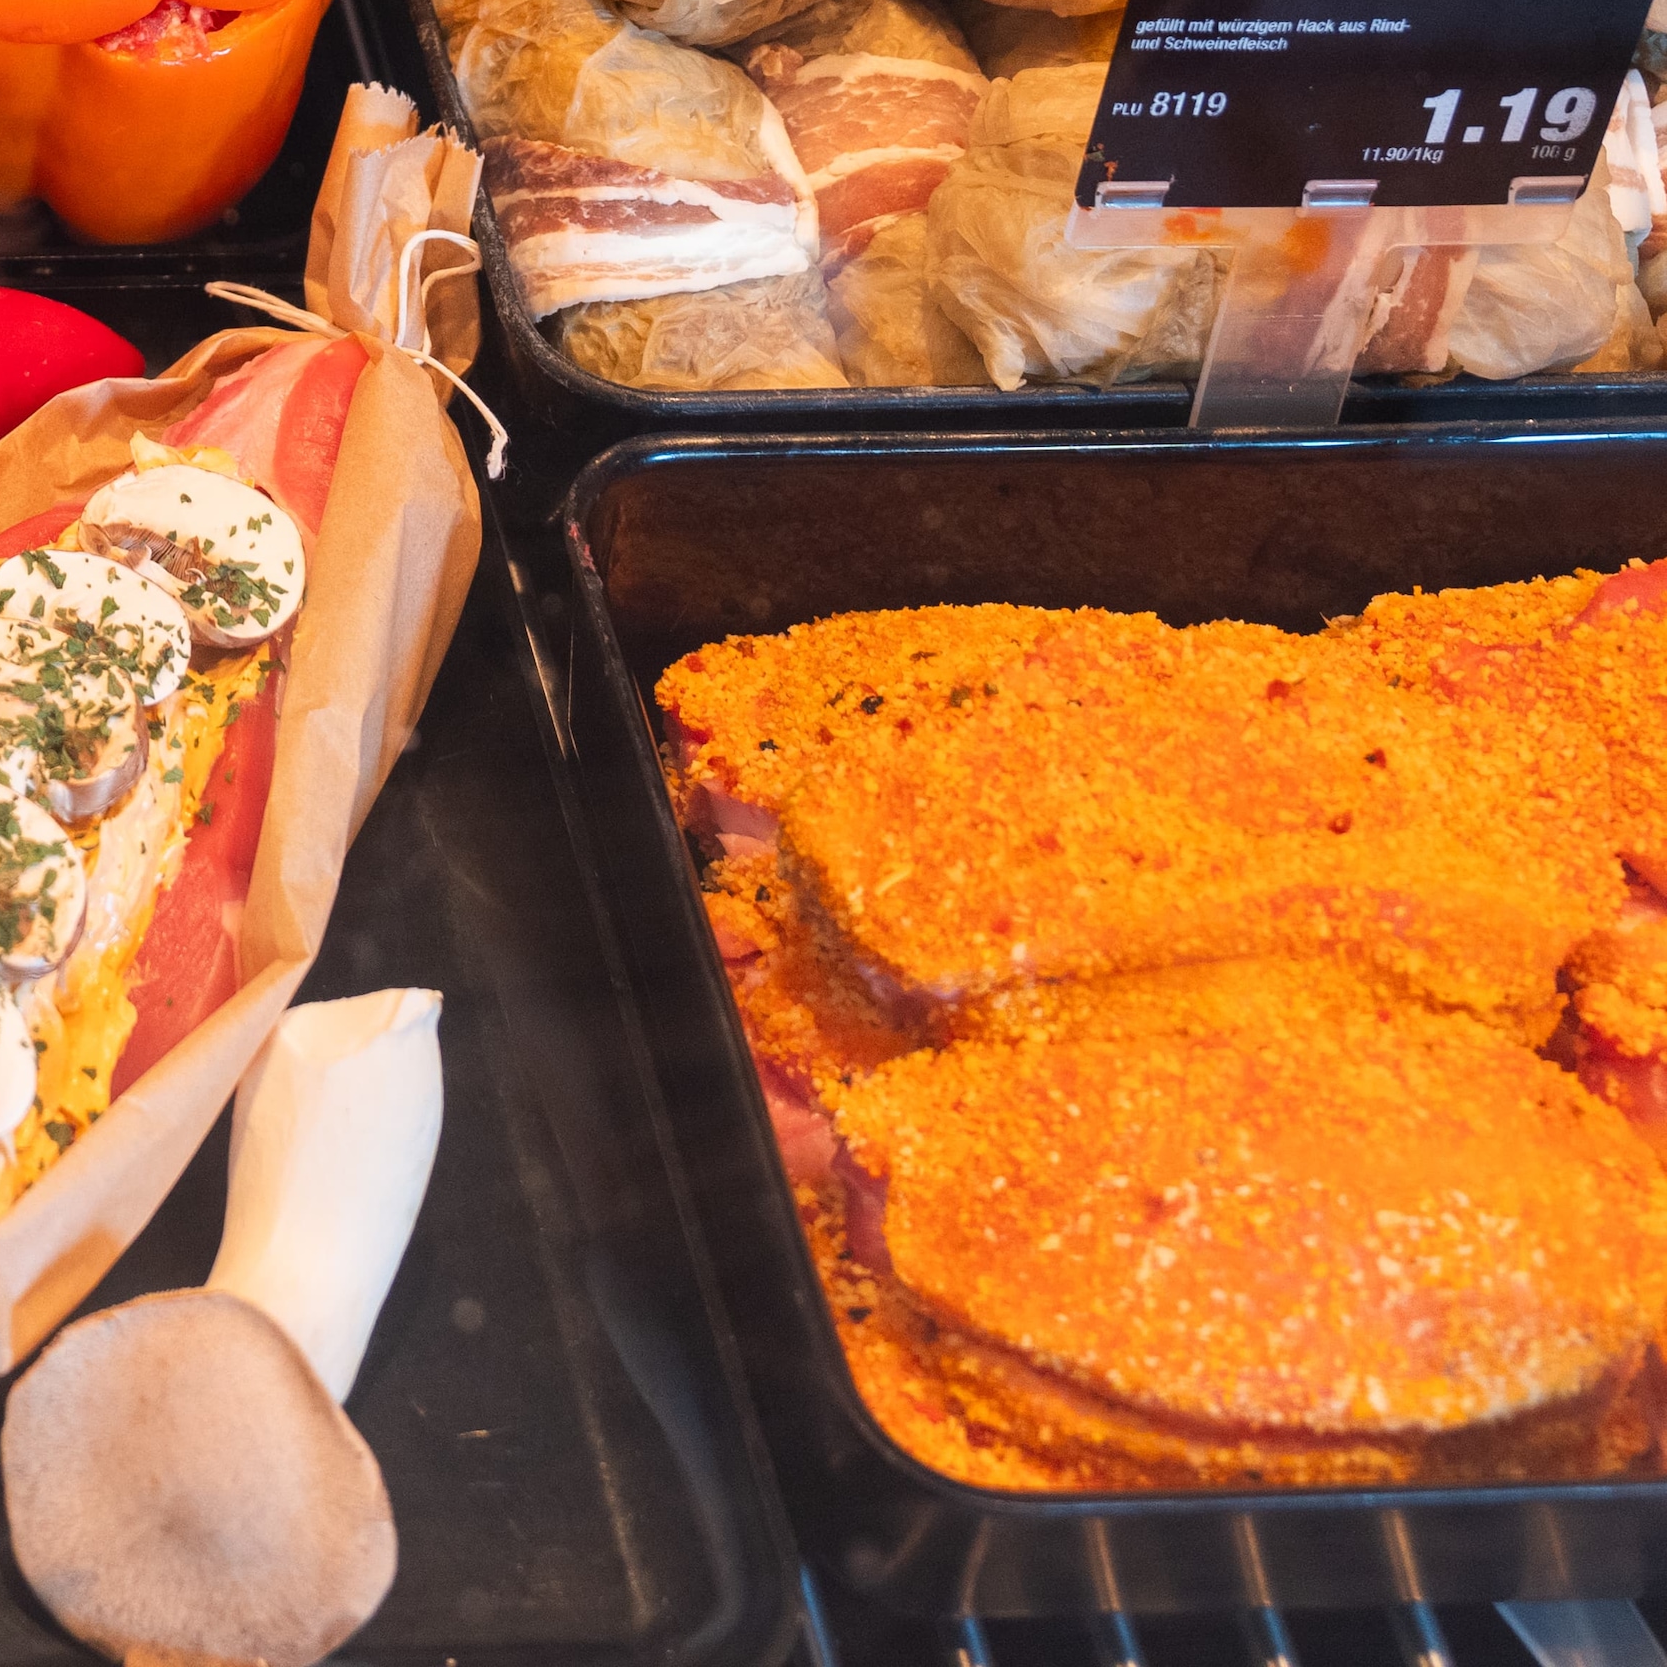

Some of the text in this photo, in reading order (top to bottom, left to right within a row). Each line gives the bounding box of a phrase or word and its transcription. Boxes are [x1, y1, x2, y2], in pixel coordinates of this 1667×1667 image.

[1136, 18, 1411, 36] gefüllt mit würzigem Hack aus Rind-
[1131, 35, 1288, 51] und Schweinefleisch
[1112, 91, 1227, 117] PLU 8119
[1422, 87, 1598, 144] 1.19
[1362, 146, 1444, 164] 11.90/1kg
[1530, 145, 1560, 160] 100
